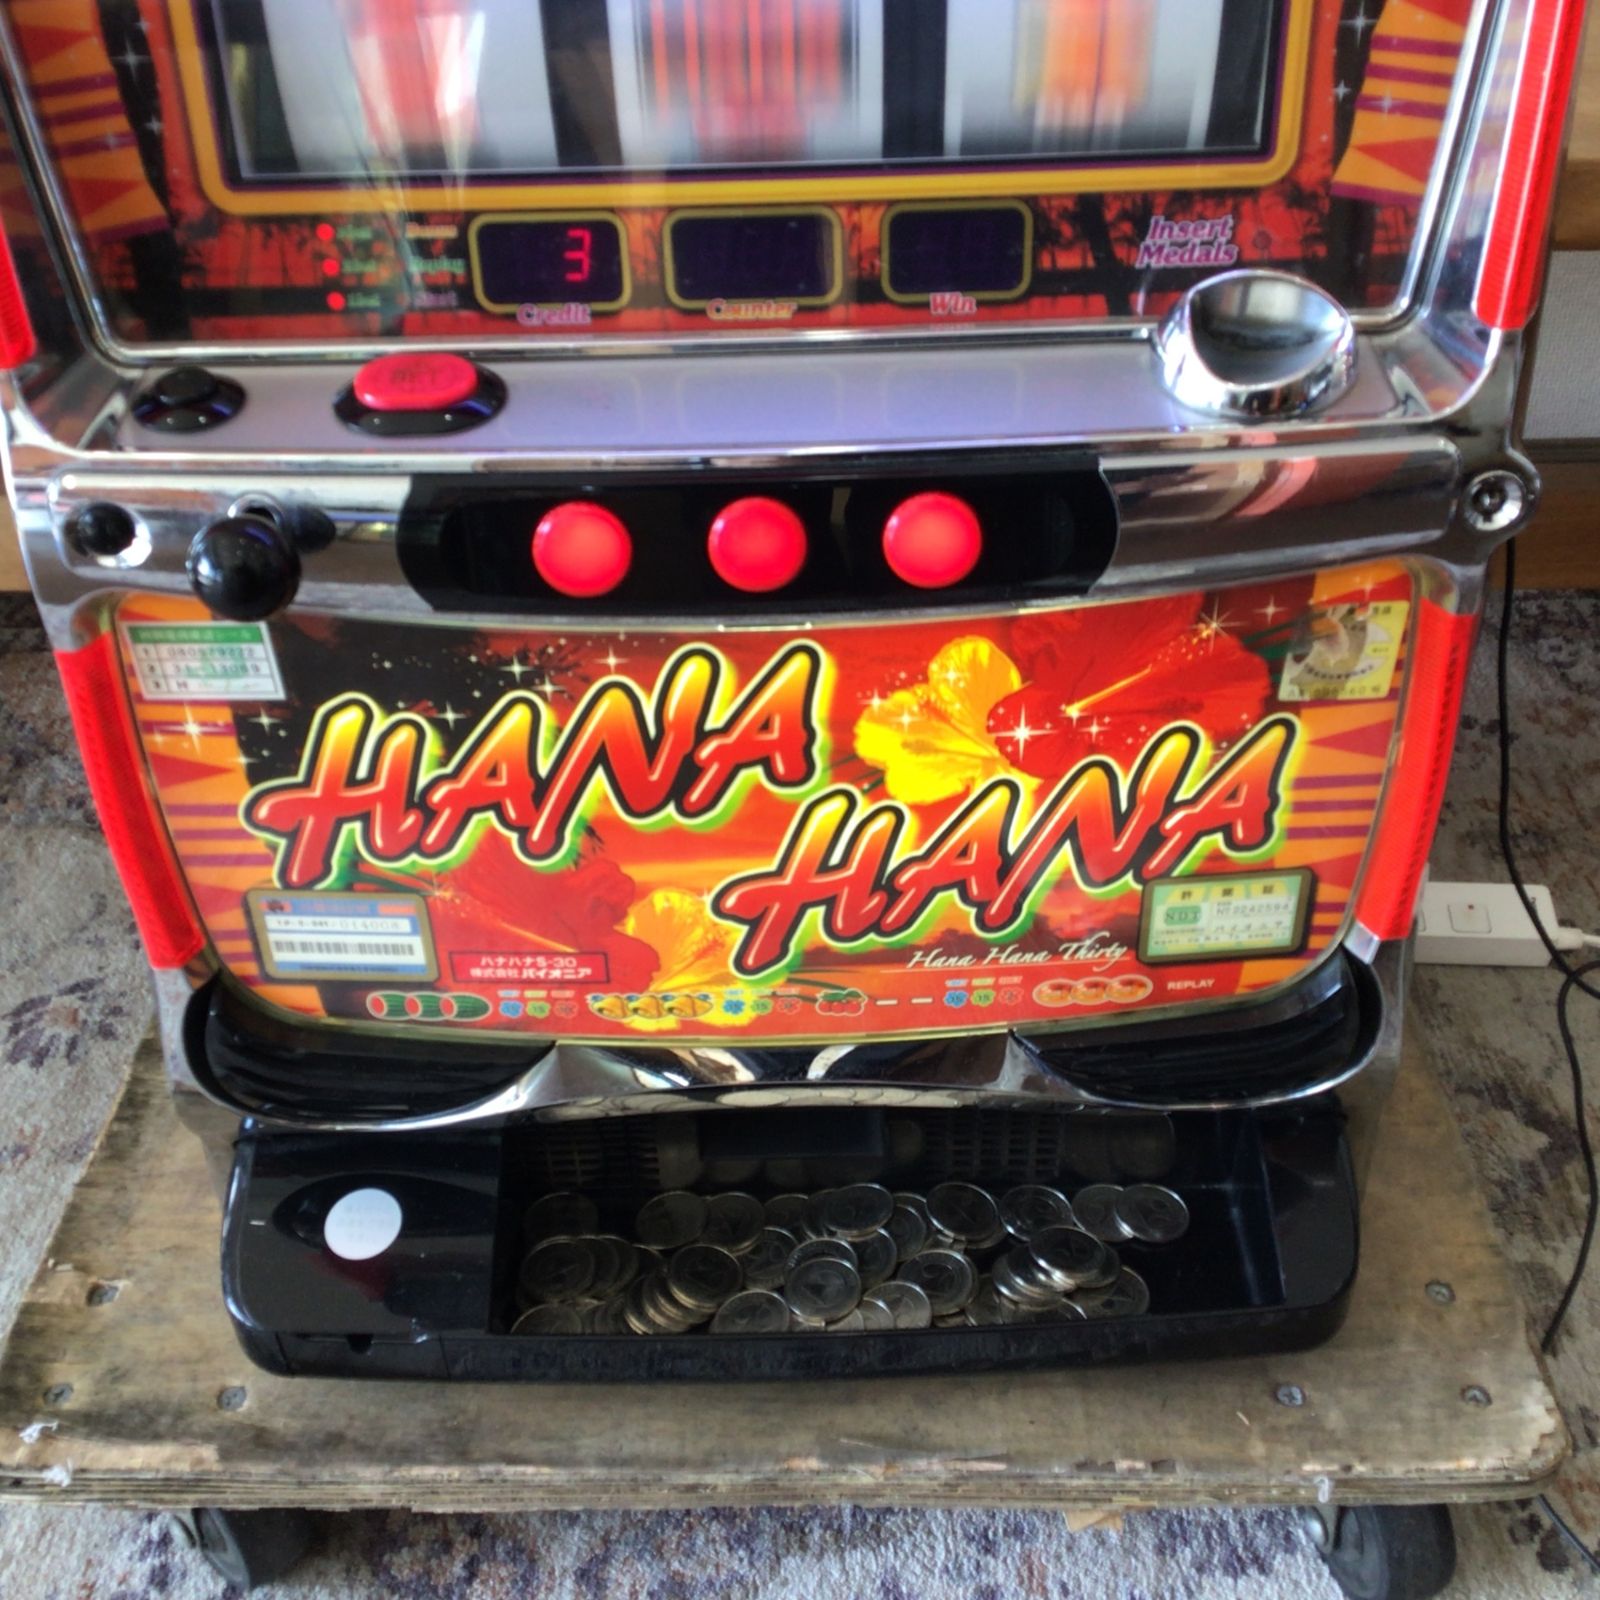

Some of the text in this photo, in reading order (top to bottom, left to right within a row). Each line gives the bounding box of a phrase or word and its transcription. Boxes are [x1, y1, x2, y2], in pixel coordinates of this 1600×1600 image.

[1147, 215, 1233, 241] Insert
[563, 228, 592, 283] 3
[1135, 241, 1238, 269] Medals
[516, 302, 592, 327] Credit
[706, 298, 798, 320] Counter
[929, 291, 978, 316] Win
[241, 641, 826, 889] HANA
[712, 714, 1298, 979] HANA
[480, 956, 578, 968] ハナハナS-30
[906, 931, 1128, 972] Hana Hana Thirty
[521, 968, 593, 980] パイオニア
[1167, 979, 1216, 991] REPLAY
